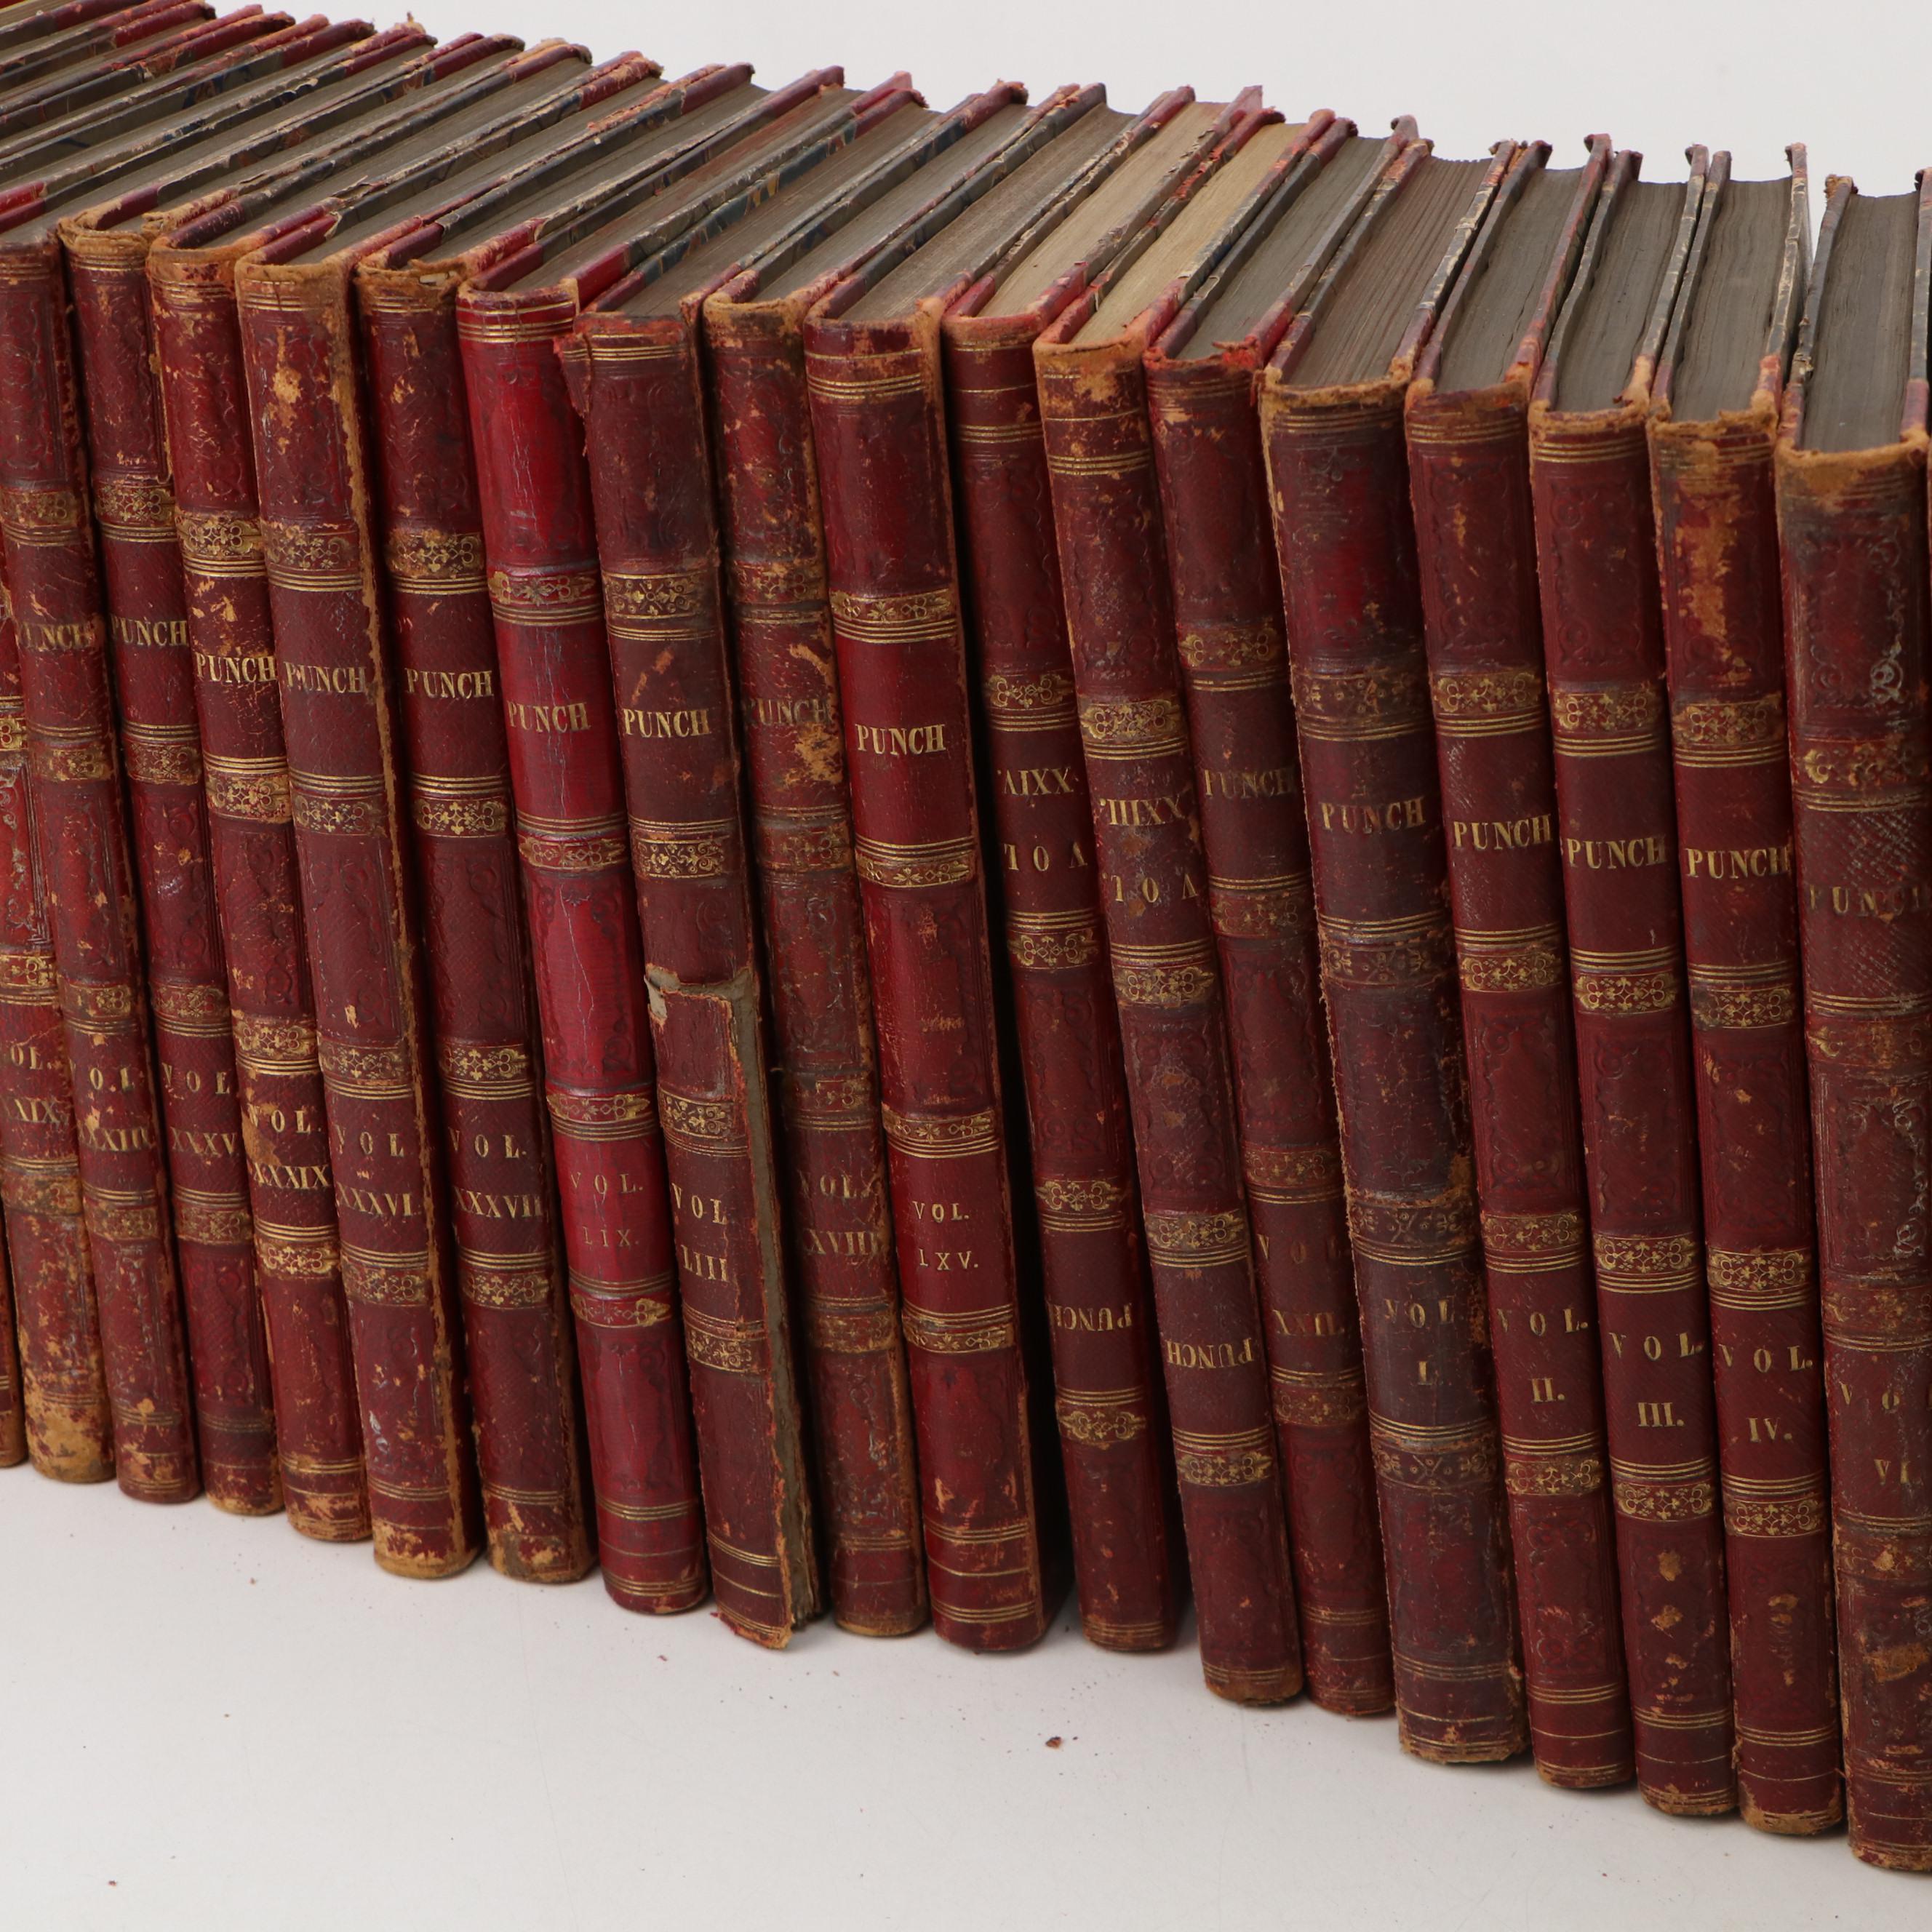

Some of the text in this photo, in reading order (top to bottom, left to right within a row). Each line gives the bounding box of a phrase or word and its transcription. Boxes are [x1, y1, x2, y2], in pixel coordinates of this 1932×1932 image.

[20, 620, 93, 650] UNCH
[111, 615, 189, 646] PUNCH
[196, 652, 277, 682] PUNCH
[284, 661, 366, 693] PUNCH
[404, 668, 494, 699] PUNCH
[507, 700, 591, 733] PUNCH
[622, 708, 711, 738] PUNCH
[855, 723, 946, 755] PUNCH
[1204, 767, 1296, 799] PUNCH
[1320, 797, 1426, 834] PUNCH
[1453, 815, 1553, 850] PUNCH
[1567, 837, 1667, 869] PUNCH
[1685, 848, 1790, 879] PUNCH
[450, 1128, 527, 1158] VOL.
[570, 1172, 644, 1194] VOL.
[671, 1183, 727, 1225] VOL
[912, 1201, 970, 1223] VOL.
[583, 1226, 639, 1247] LIX.
[681, 1245, 728, 1282] LIII
[919, 1249, 978, 1271] LXV.
[1497, 1308, 1588, 1336] VOL.
[1165, 1337, 1254, 1369] PUNCH
[1609, 1333, 1703, 1361] VOL.
[1719, 1344, 1813, 1373] VOL.
[1528, 1378, 1565, 1402] II.
[1637, 1402, 1685, 1426] III.
[1747, 1418, 1792, 1442] IV.
